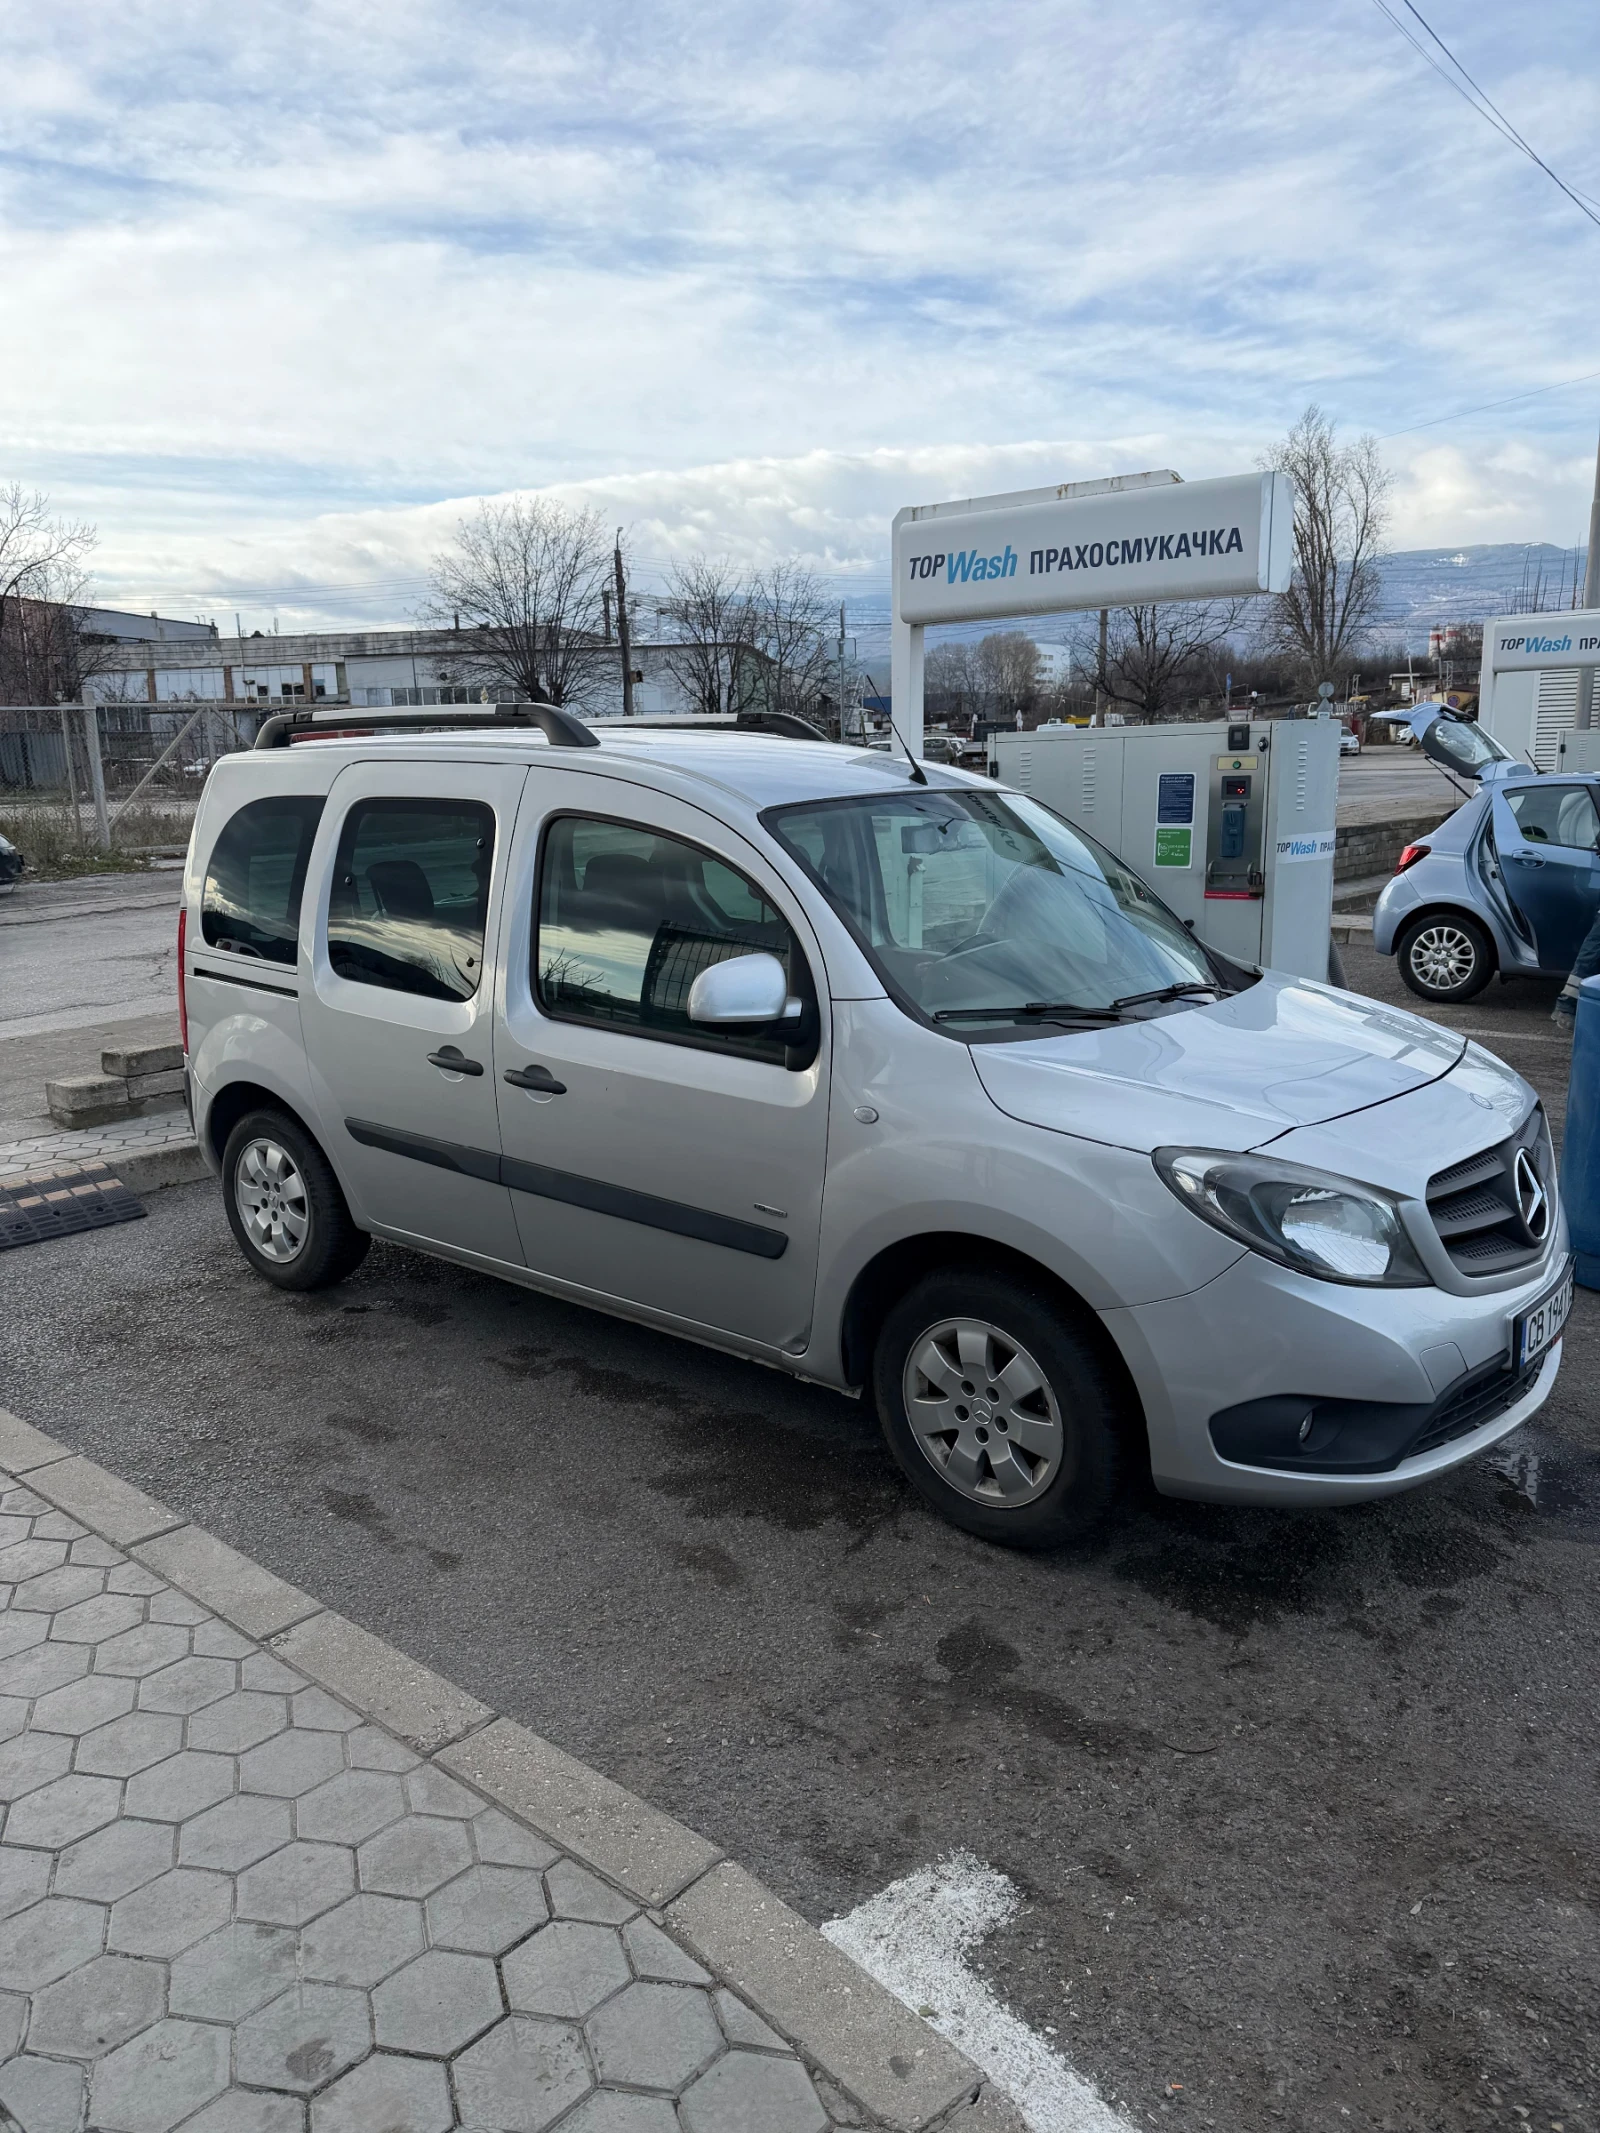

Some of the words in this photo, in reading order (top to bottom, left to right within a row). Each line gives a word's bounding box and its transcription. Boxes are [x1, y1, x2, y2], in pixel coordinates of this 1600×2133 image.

[909, 545, 1018, 584] TOPWash
[1029, 527, 1244, 575] ПРАХОСМУКАЧКА
[1500, 634, 1572, 653] TOPWash
